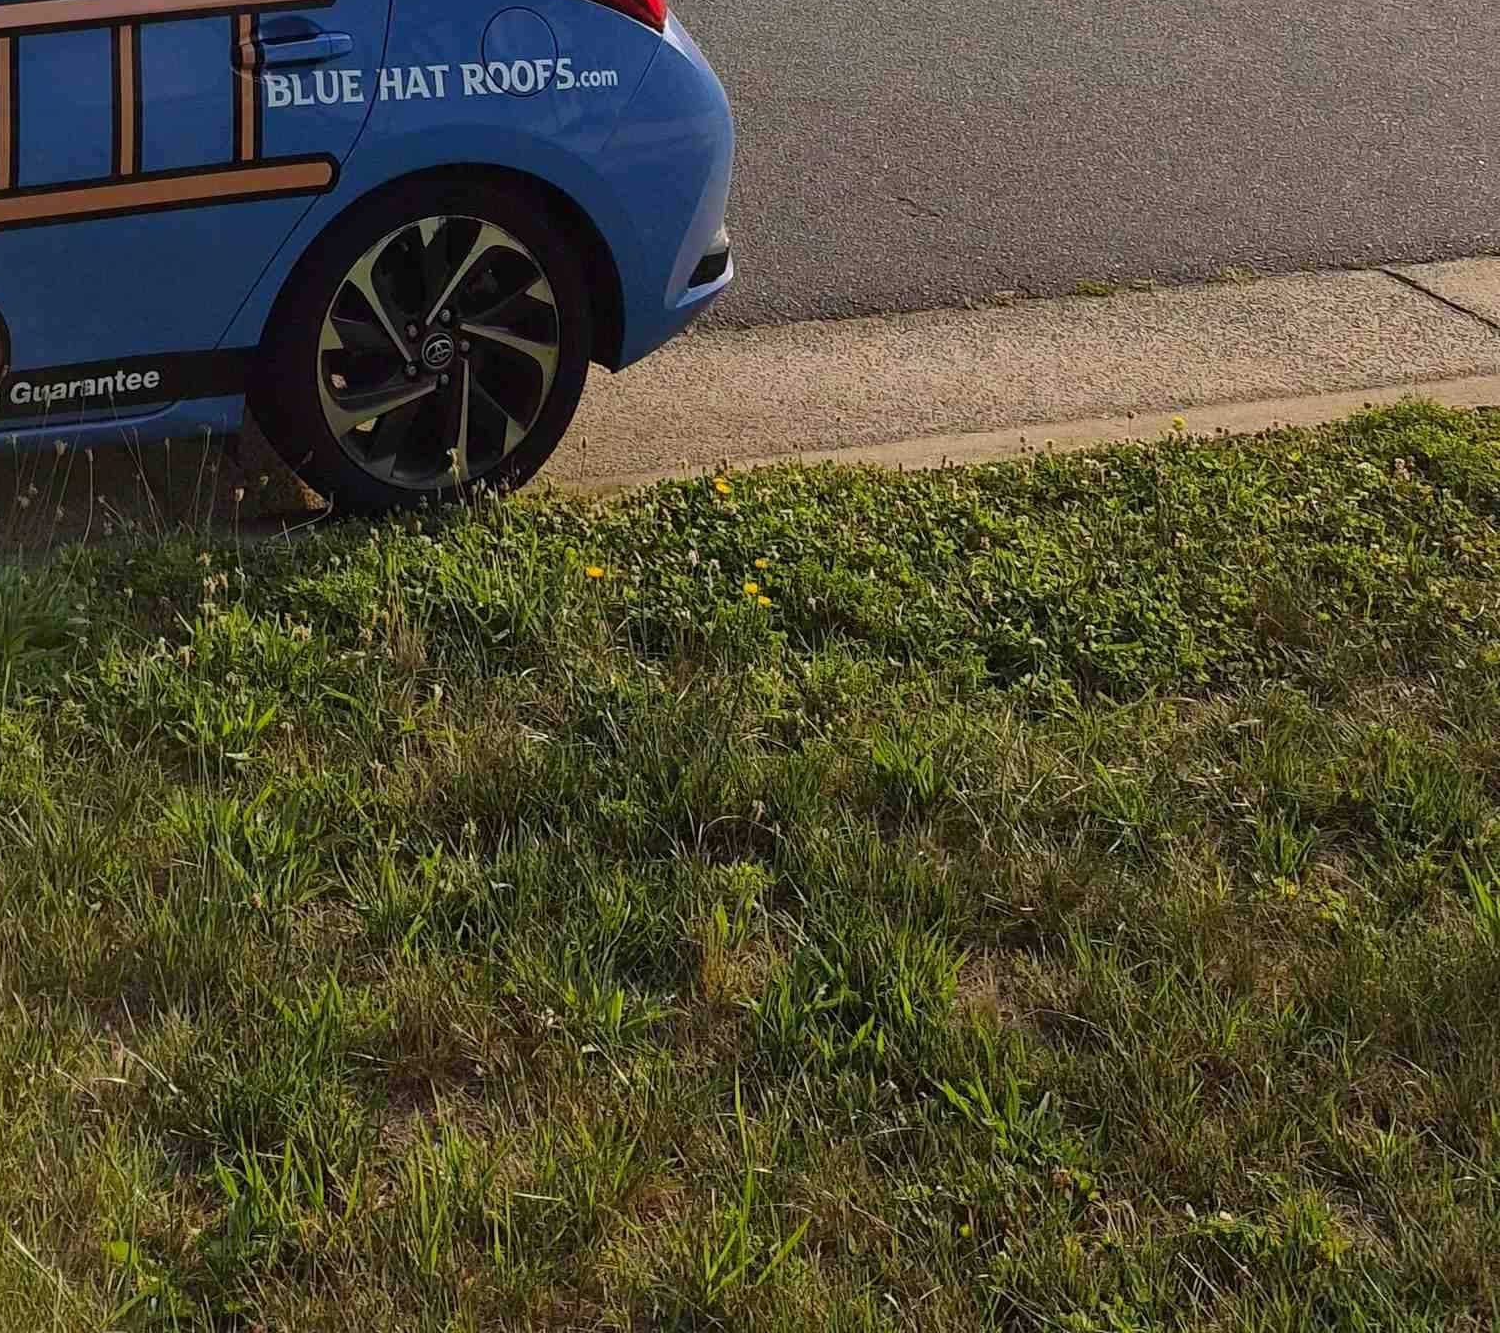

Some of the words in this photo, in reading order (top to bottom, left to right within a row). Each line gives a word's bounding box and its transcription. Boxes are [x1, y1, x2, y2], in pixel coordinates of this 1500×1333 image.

[263, 69, 364, 108] BLUE
[376, 64, 449, 101] HAT
[10, 369, 160, 405] Guarantee
